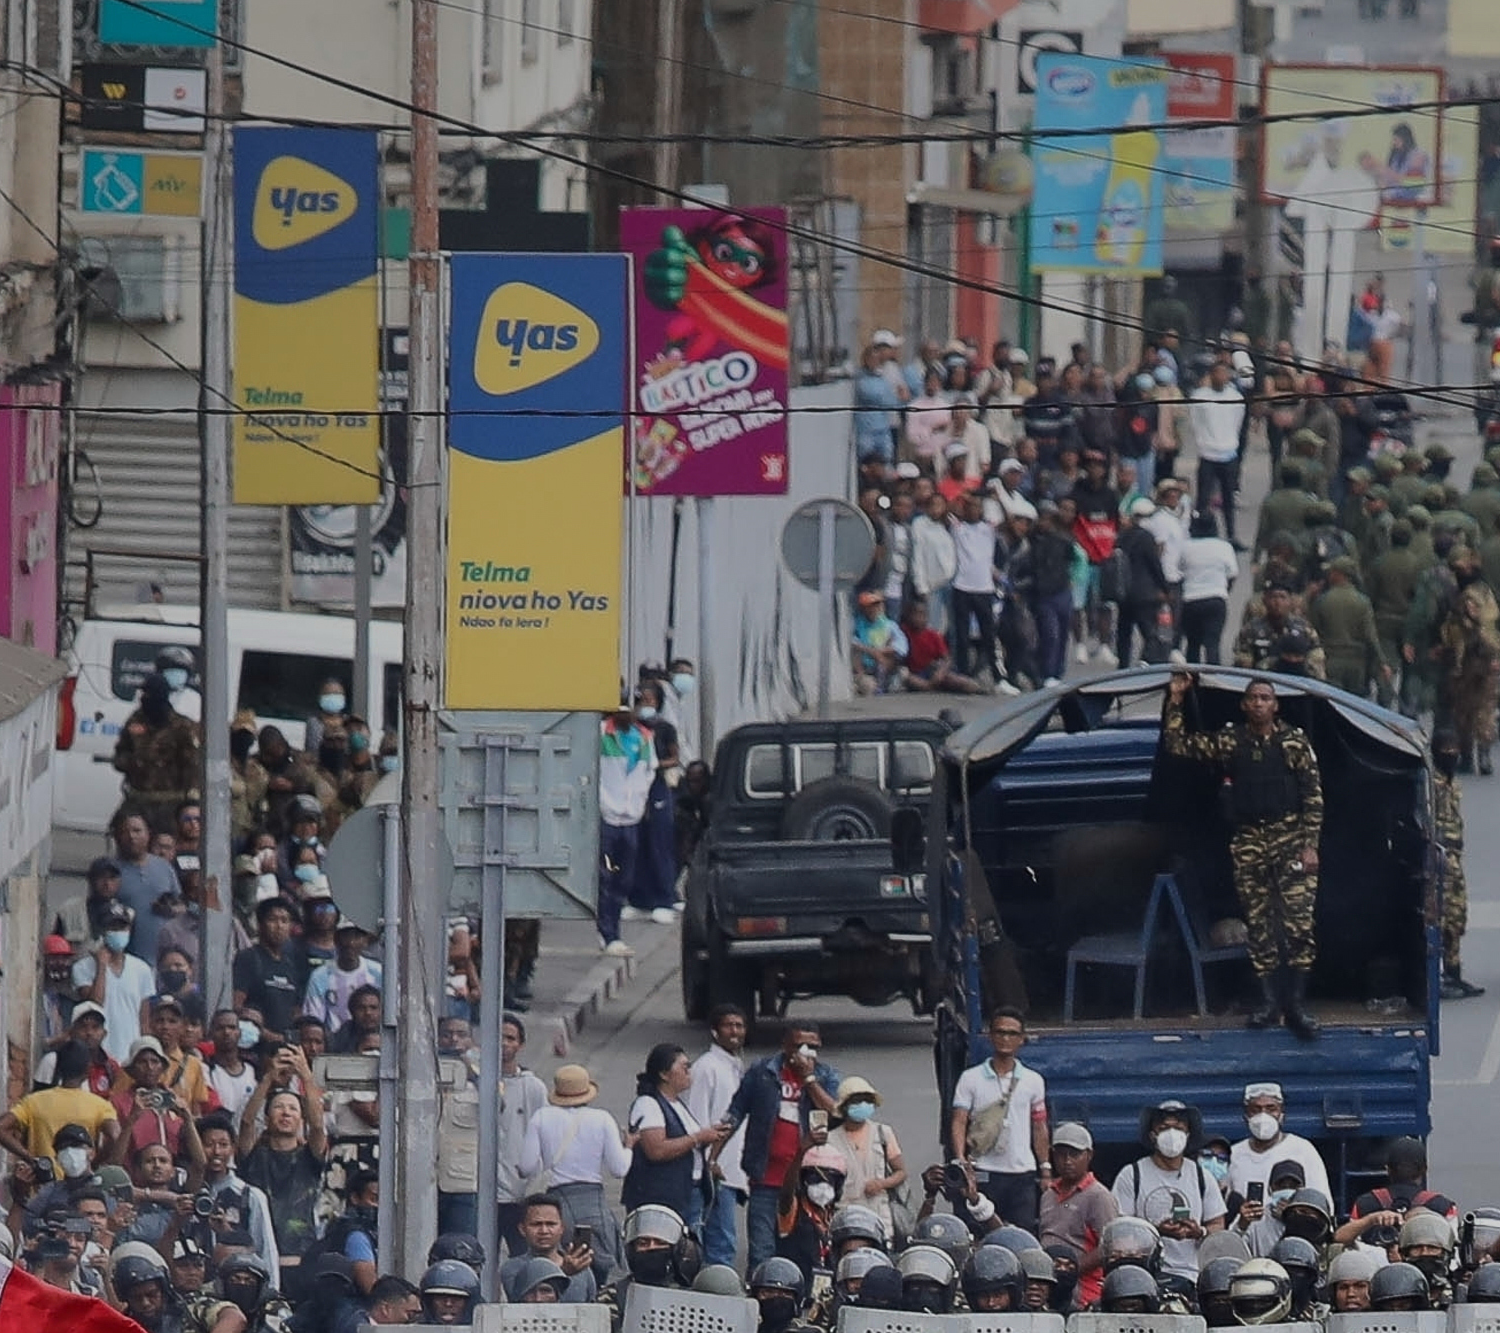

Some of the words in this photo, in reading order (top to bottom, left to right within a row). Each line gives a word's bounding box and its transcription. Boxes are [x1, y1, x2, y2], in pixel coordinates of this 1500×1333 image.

[244, 387, 303, 405] Telma
[459, 562, 529, 582] Telma
[459, 592, 525, 610] niova
[527, 591, 560, 610] ho
[566, 591, 607, 610] Yas
